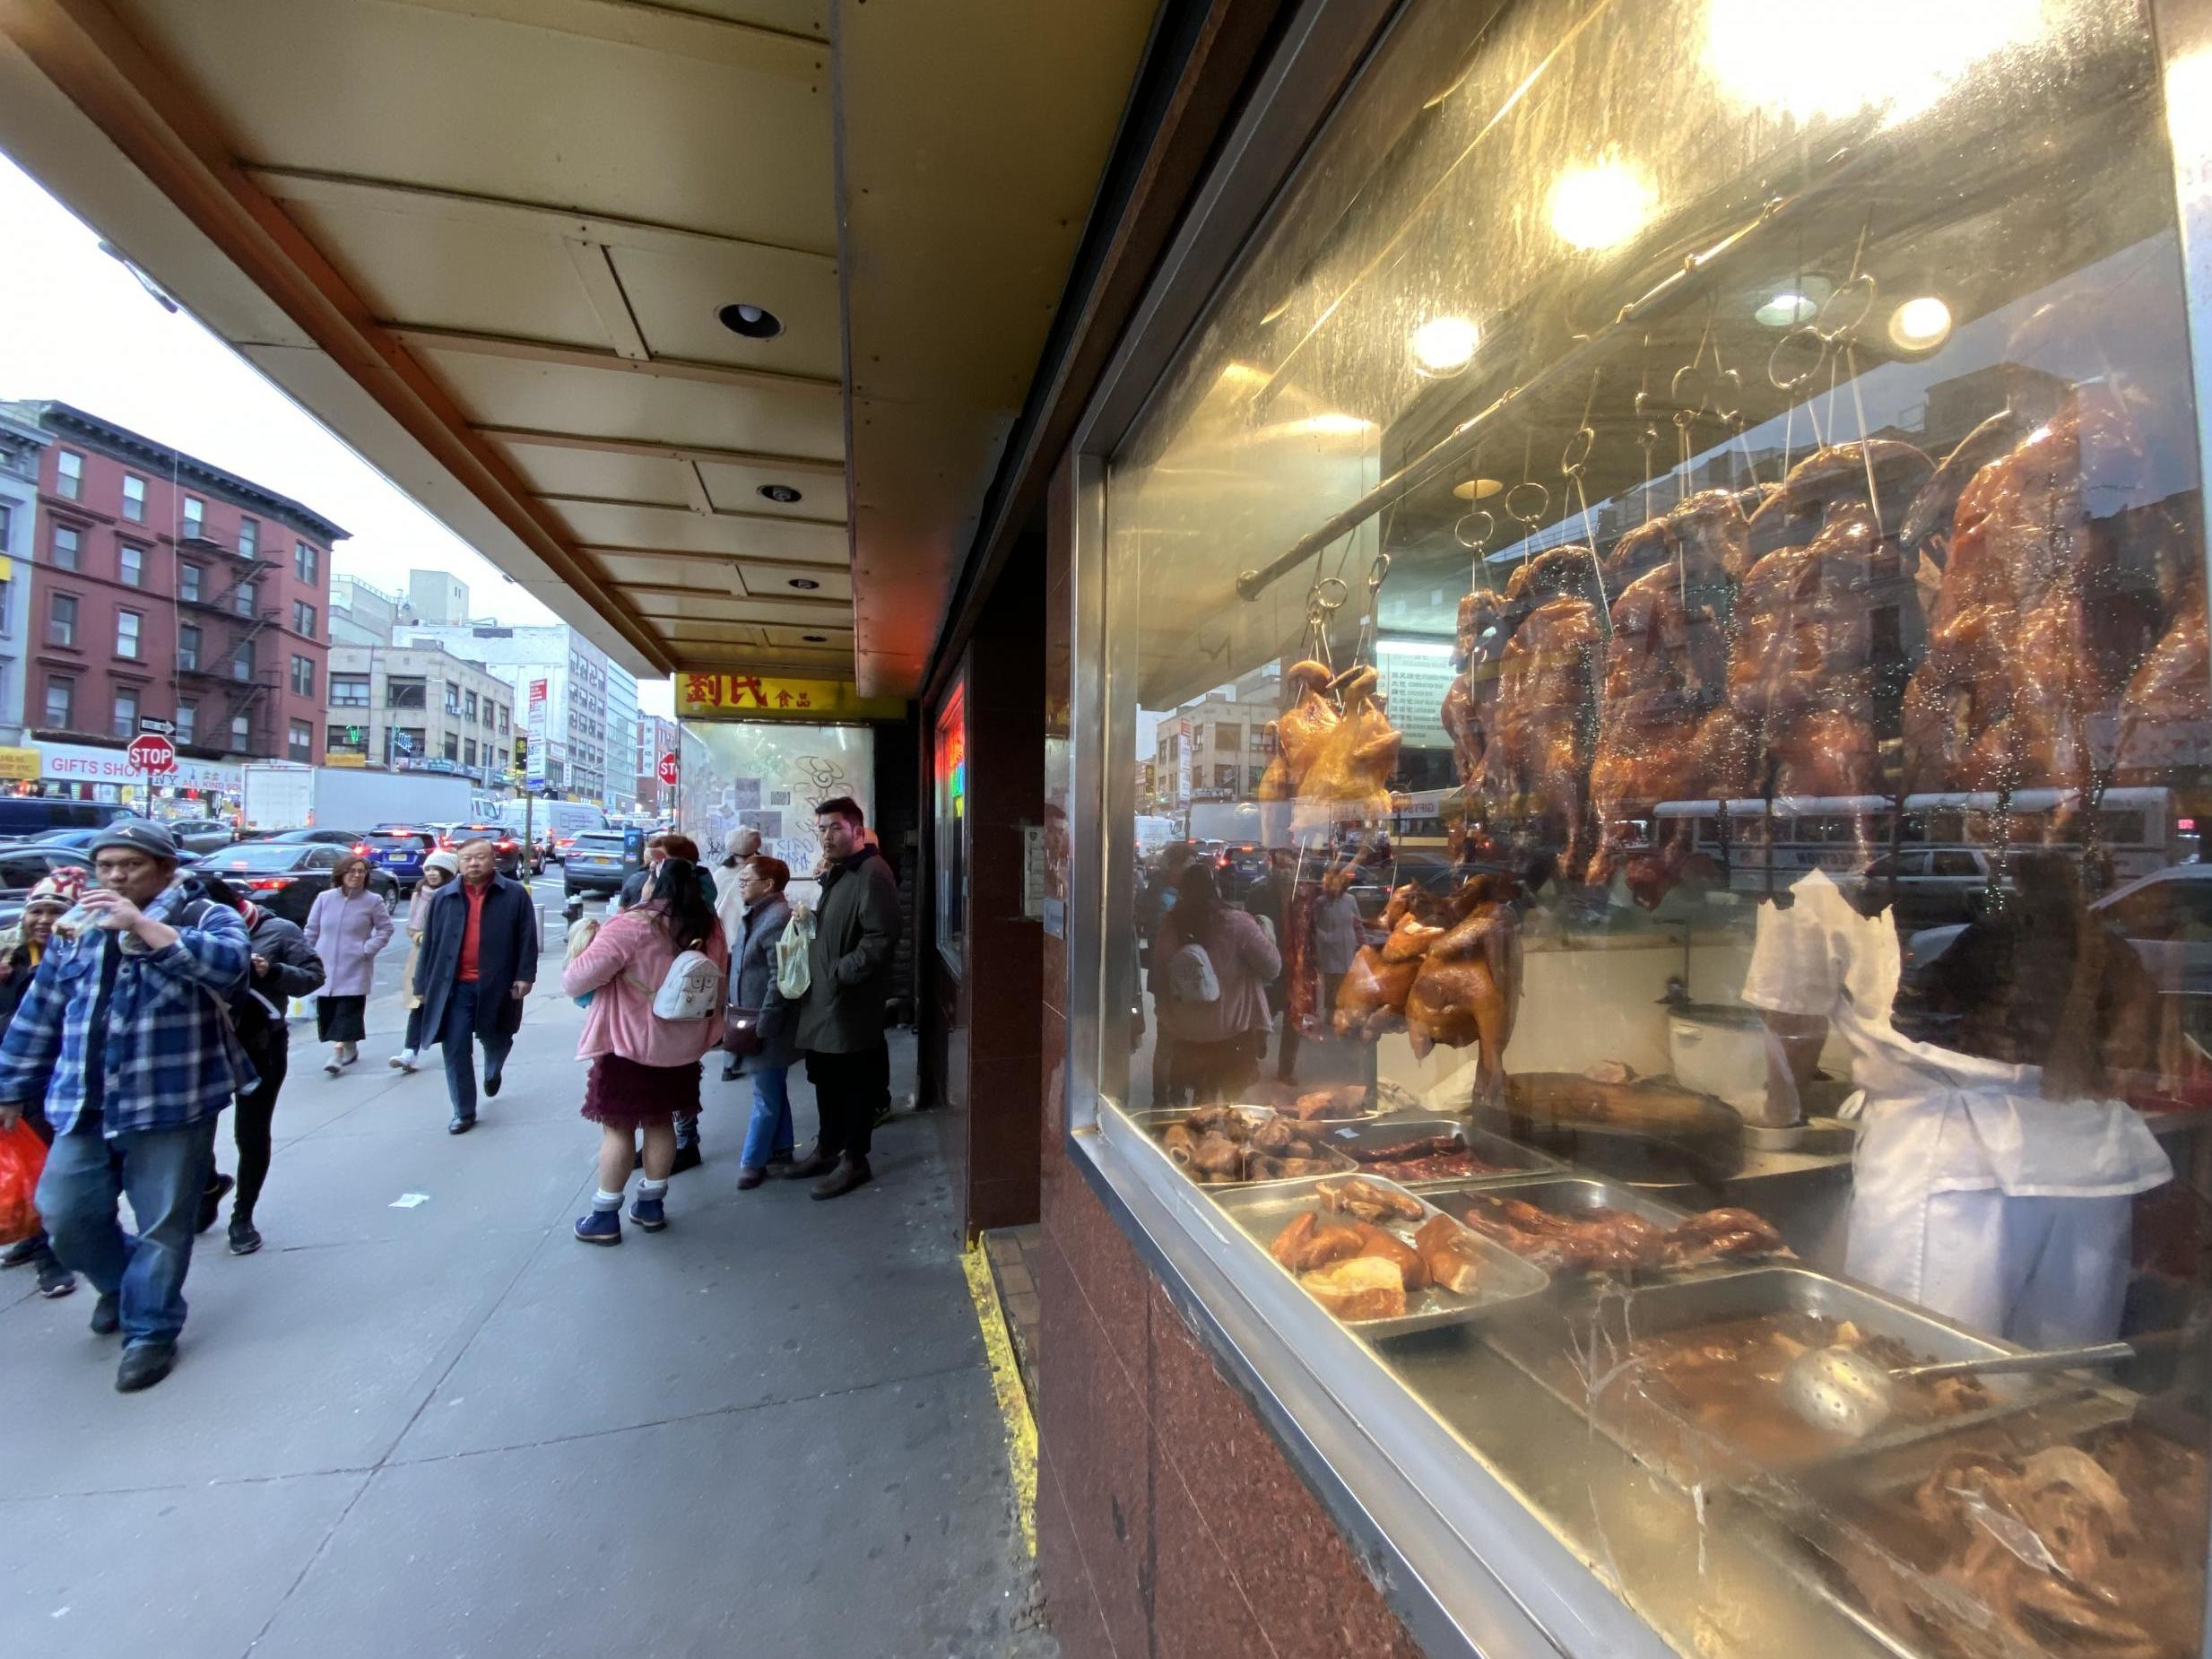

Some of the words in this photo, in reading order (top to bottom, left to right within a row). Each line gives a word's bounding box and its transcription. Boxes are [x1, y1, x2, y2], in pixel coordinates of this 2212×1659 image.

[131, 748, 171, 764] STOP
[52, 758, 98, 774] GIFTS
[103, 761, 139, 777] SHO
[660, 762, 678, 776] ST
[628, 836, 636, 847] P
